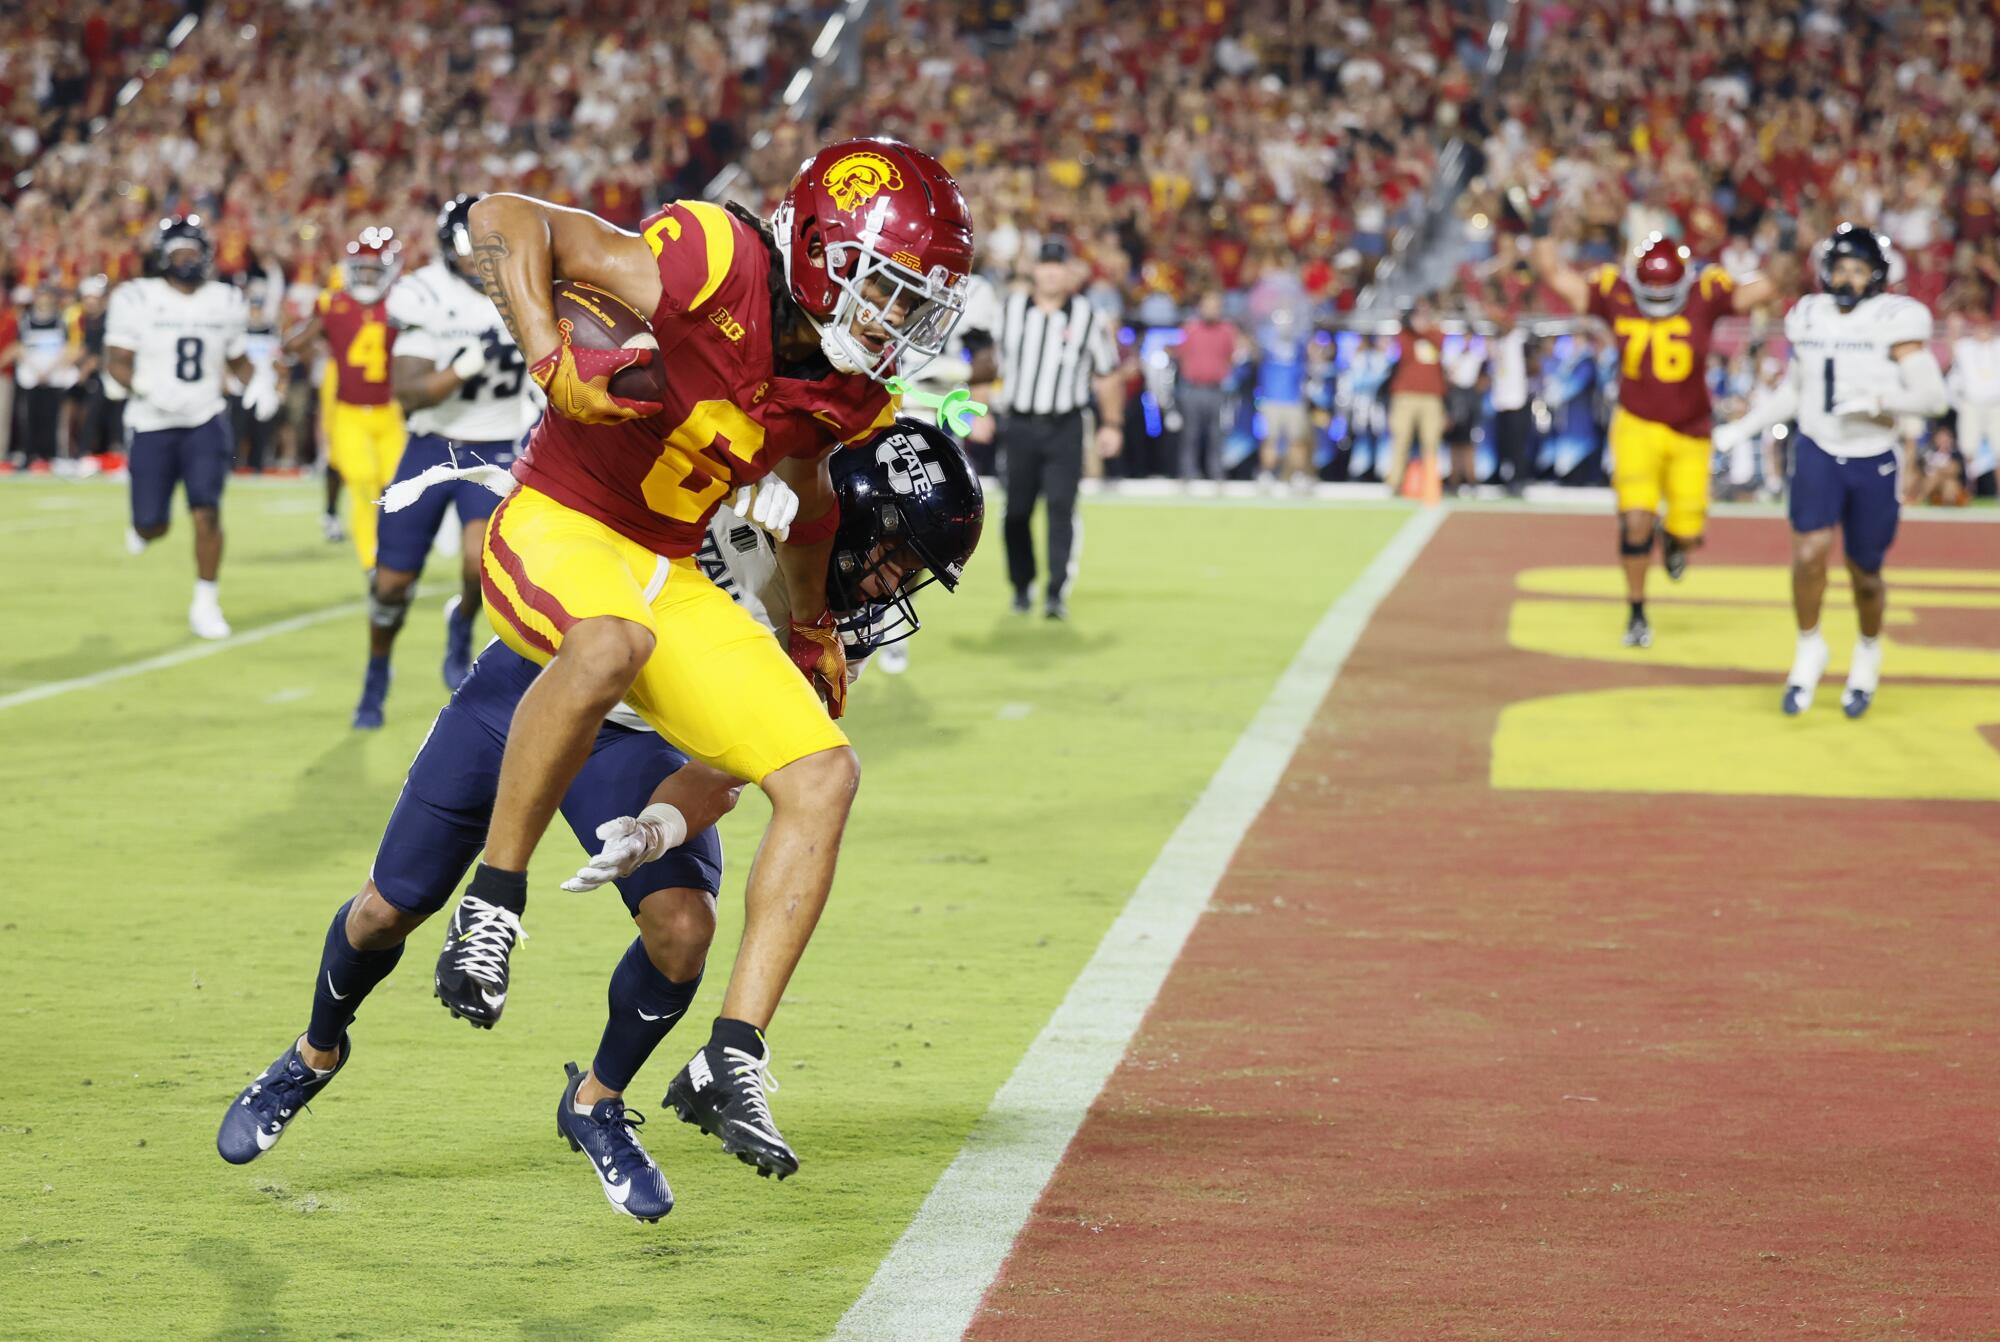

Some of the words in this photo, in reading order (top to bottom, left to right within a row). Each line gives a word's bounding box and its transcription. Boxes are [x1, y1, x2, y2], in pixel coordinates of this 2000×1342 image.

[176, 336, 204, 383] 8
[346, 321, 388, 384] 4
[1614, 315, 1694, 383] 76
[1824, 357, 1835, 414] 1
[640, 398, 766, 524] 6
[886, 433, 933, 495] STATE
[688, 1049, 714, 1093] NIKE
